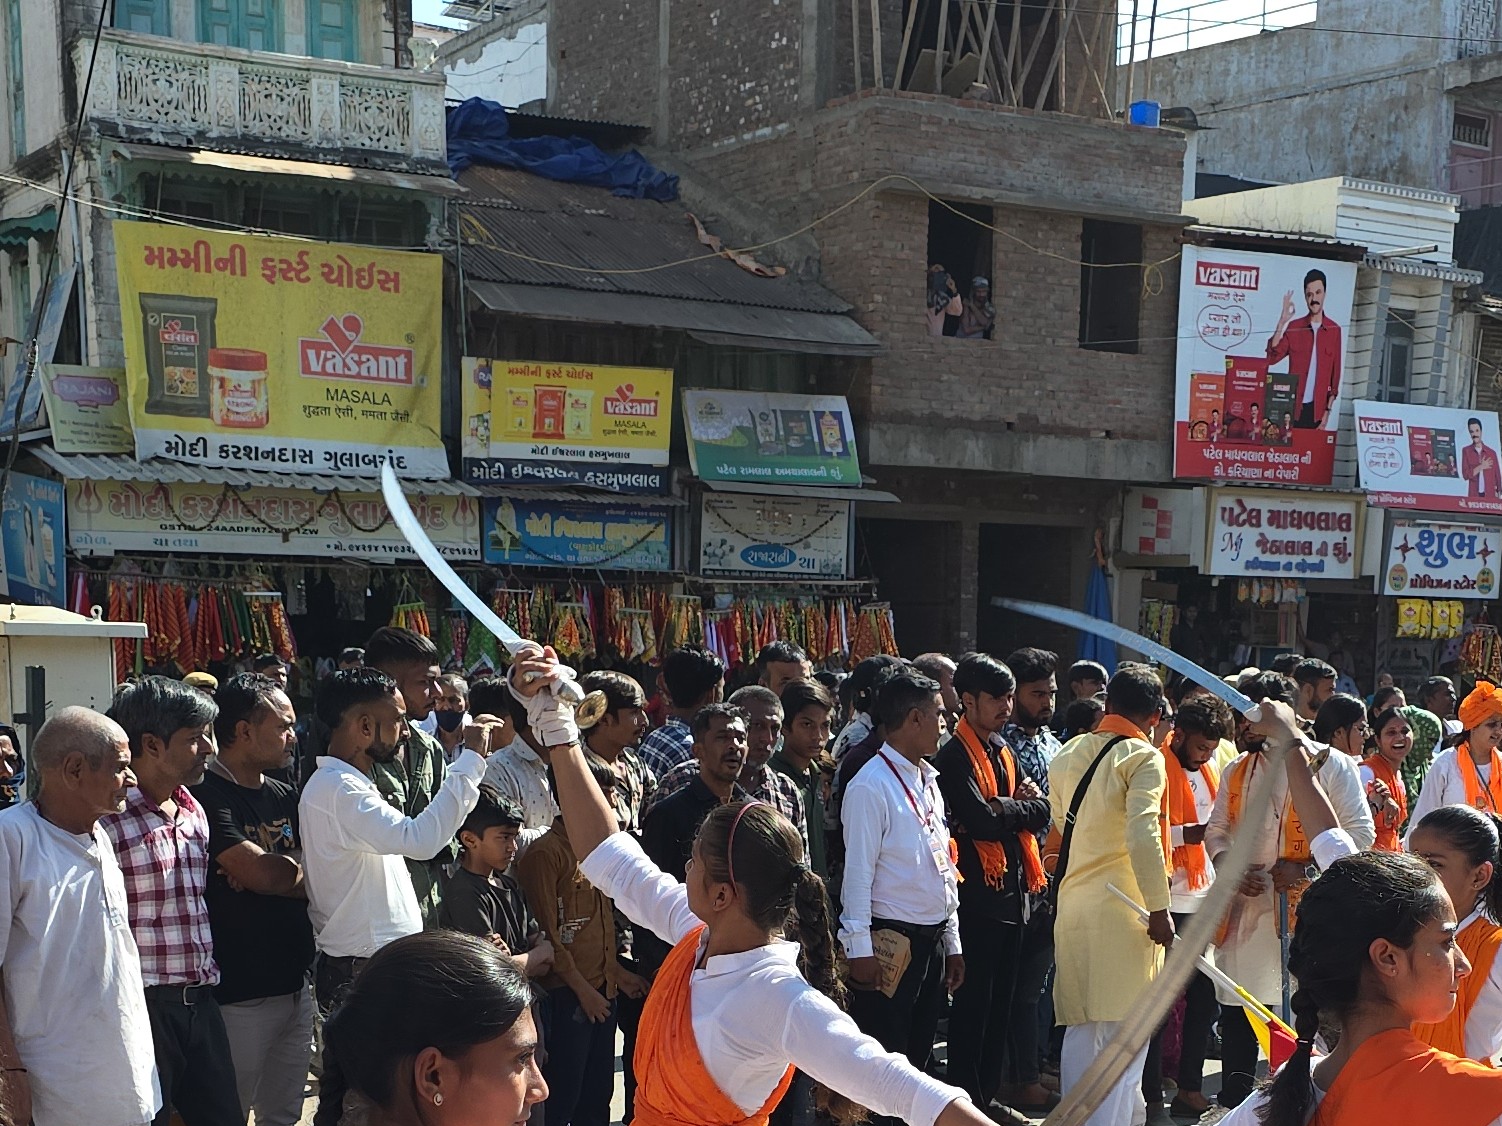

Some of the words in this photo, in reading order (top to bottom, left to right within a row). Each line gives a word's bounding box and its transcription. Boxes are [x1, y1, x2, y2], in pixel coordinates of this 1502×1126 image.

[144, 240, 246, 277] મમ્મીની
[261, 251, 311, 285] ફર્સ્ટ
[326, 387, 391, 406] MASALA
[614, 420, 646, 429] MASALA
[165, 434, 208, 459] મોદી
[218, 443, 314, 465] કરશનદાસ
[1202, 446, 1223, 459] પટેલ
[472, 461, 504, 480] મોદી
[1221, 498, 1261, 528] પટેલ
[1267, 509, 1352, 532] માધવલાલ
[152, 537, 170, 547] ચા
[1415, 529, 1477, 568] શુભ
